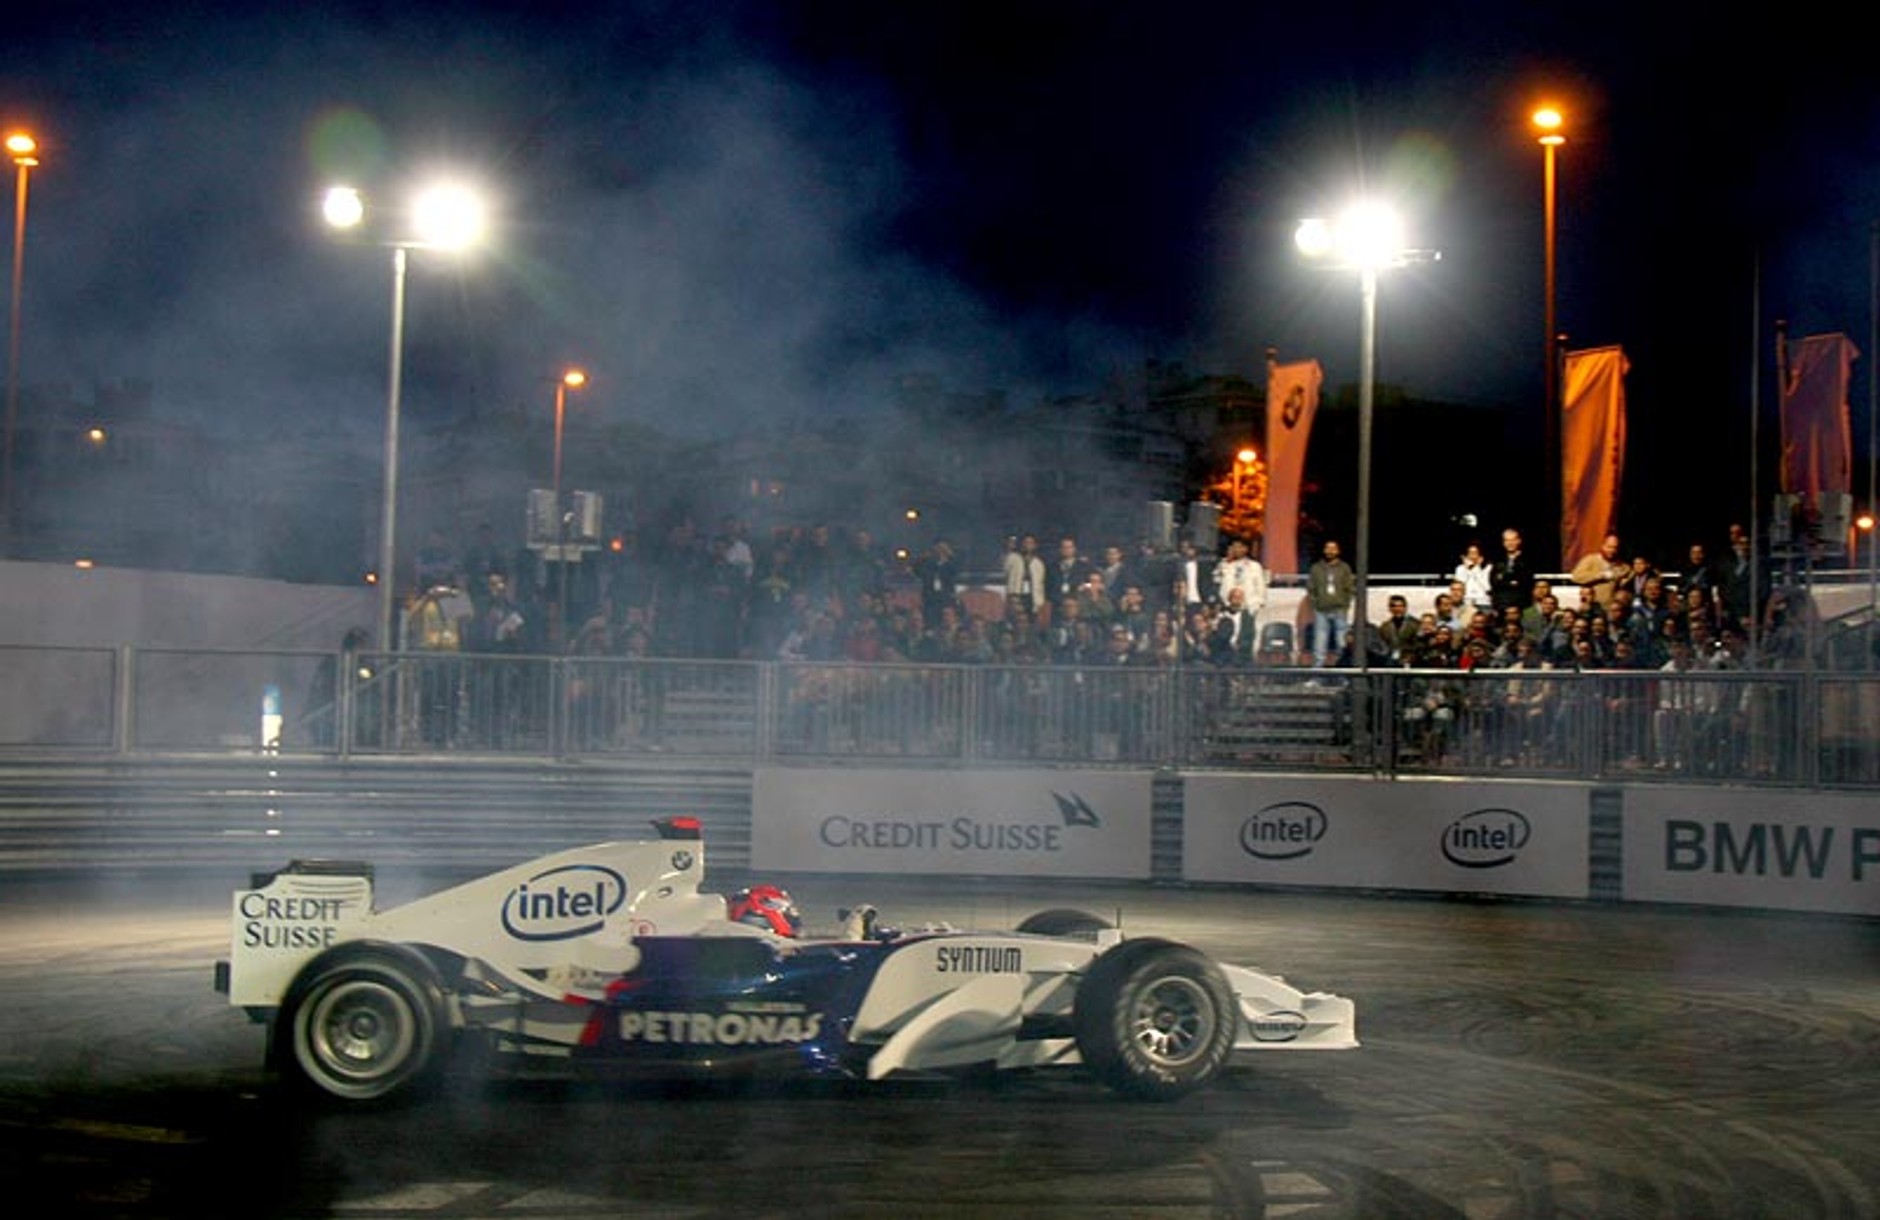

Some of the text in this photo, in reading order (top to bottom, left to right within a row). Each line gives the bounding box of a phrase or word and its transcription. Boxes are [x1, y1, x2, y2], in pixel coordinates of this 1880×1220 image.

[820, 815, 1061, 851] CREDIT SUISSE
[1252, 817, 1313, 842] intel
[1453, 823, 1516, 850] intel
[1666, 820, 1880, 881] BMW P
[240, 893, 342, 920] CREDIT
[519, 881, 605, 919] intel
[245, 921, 336, 948] SUISSE
[937, 946, 1022, 973] SYNTIUM
[619, 1012, 824, 1045] PETRONAS
